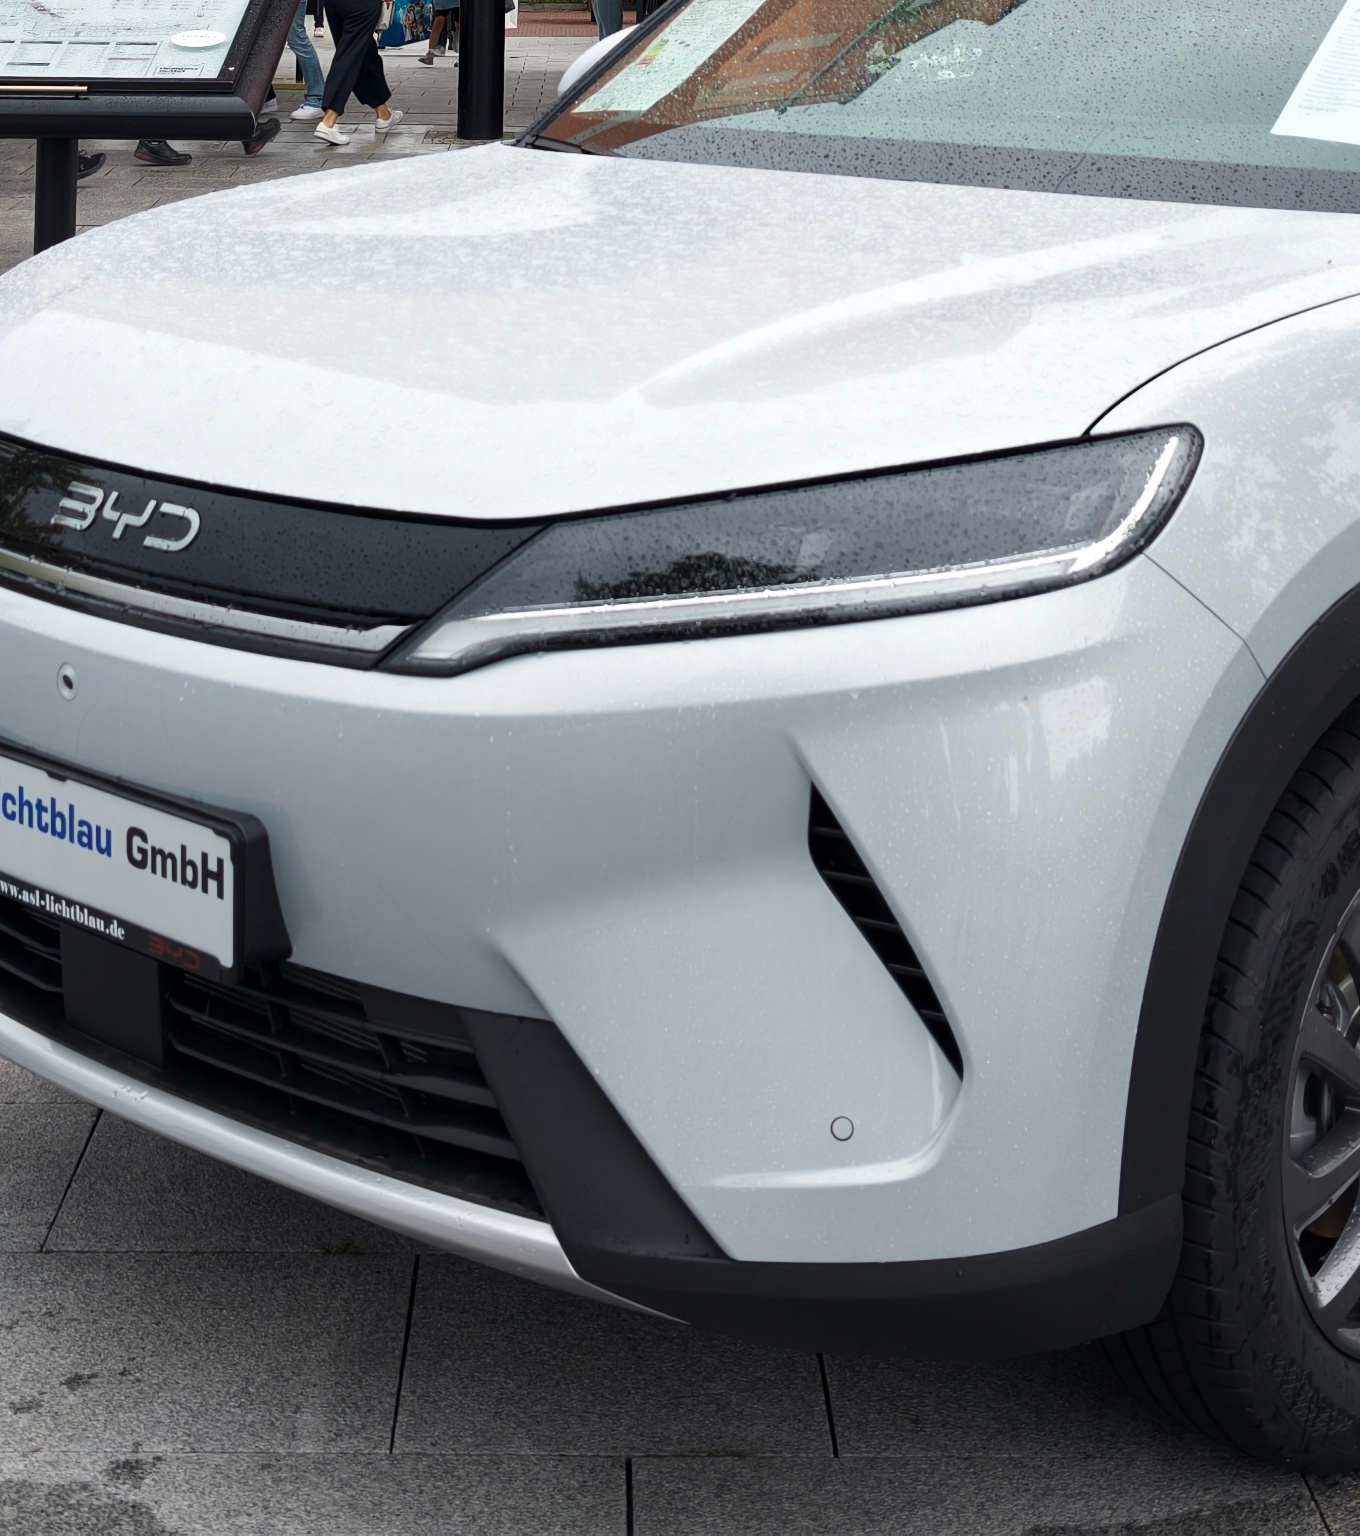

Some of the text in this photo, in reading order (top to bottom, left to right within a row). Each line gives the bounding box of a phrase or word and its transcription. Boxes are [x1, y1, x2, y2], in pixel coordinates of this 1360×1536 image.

[51, 481, 201, 552] BYD
[125, 825, 225, 901] GmbH
[147, 934, 201, 970] BYD
